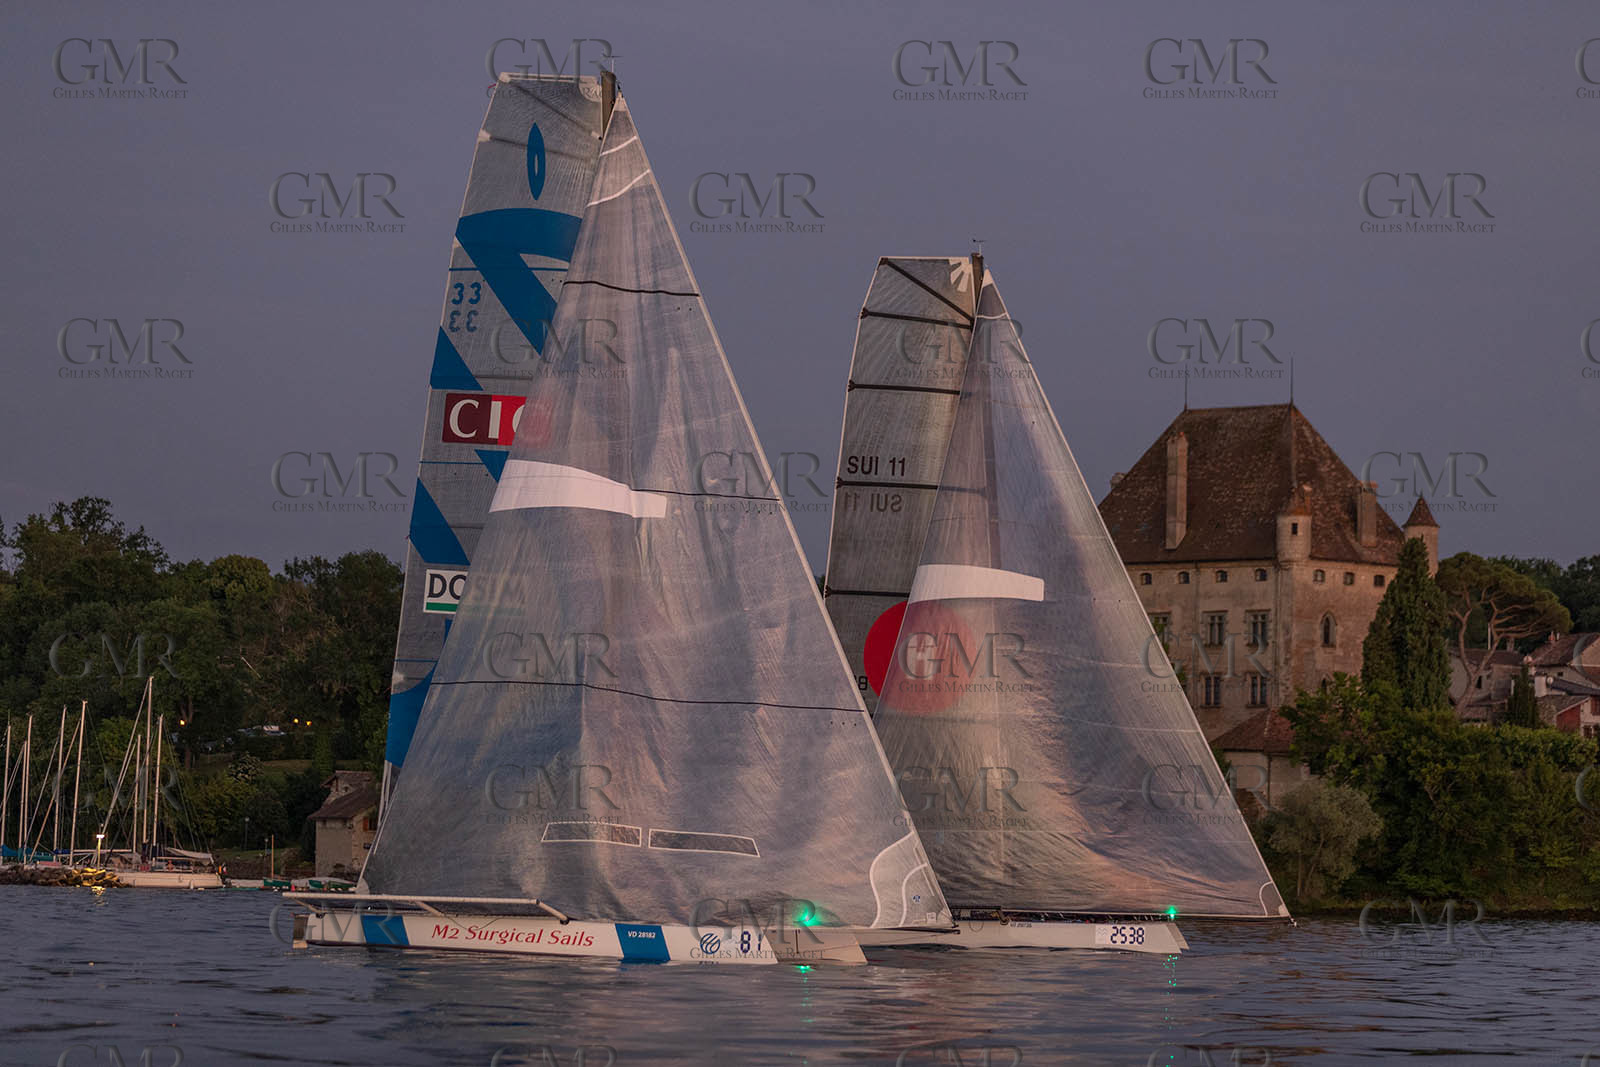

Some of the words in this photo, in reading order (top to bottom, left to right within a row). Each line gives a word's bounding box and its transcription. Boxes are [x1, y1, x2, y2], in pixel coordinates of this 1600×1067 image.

[451, 282, 482, 305] 33
[847, 456, 879, 475] SUI
[889, 457, 906, 476] 11
[432, 925, 460, 940] M2
[465, 925, 544, 945] Surgical
[548, 930, 595, 947] Sails
[627, 930, 638, 939] VD
[1110, 926, 1145, 945] 2538
